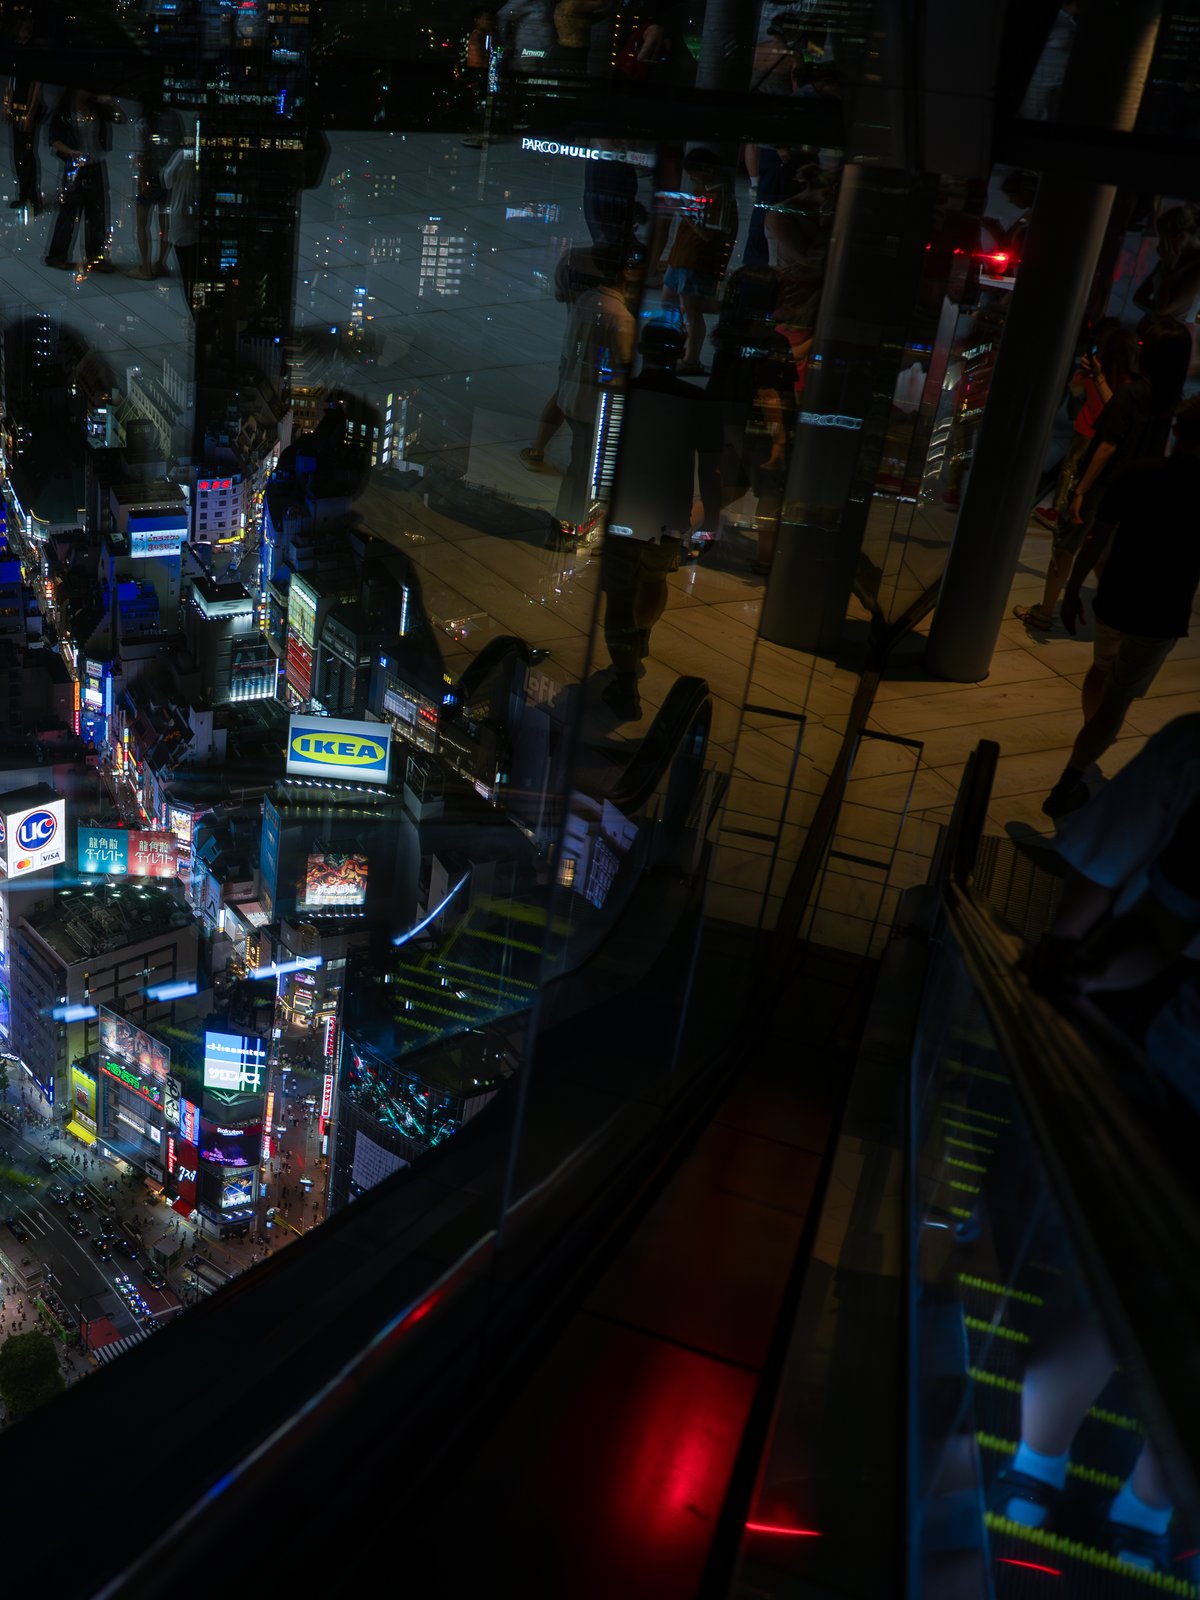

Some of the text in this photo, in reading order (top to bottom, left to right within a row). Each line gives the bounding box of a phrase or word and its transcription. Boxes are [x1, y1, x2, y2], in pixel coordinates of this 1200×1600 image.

[521, 49, 545, 58] Amway
[522, 138, 600, 160] PARCO HULIC
[300, 737, 379, 760] IKEA
[21, 817, 54, 843] UC
[88, 837, 119, 850] 龍角散
[138, 840, 169, 854] 龍角散
[42, 851, 60, 861] VISA
[85, 848, 124, 862] ダイレクト
[216, 1127, 244, 1136] Rakuten
